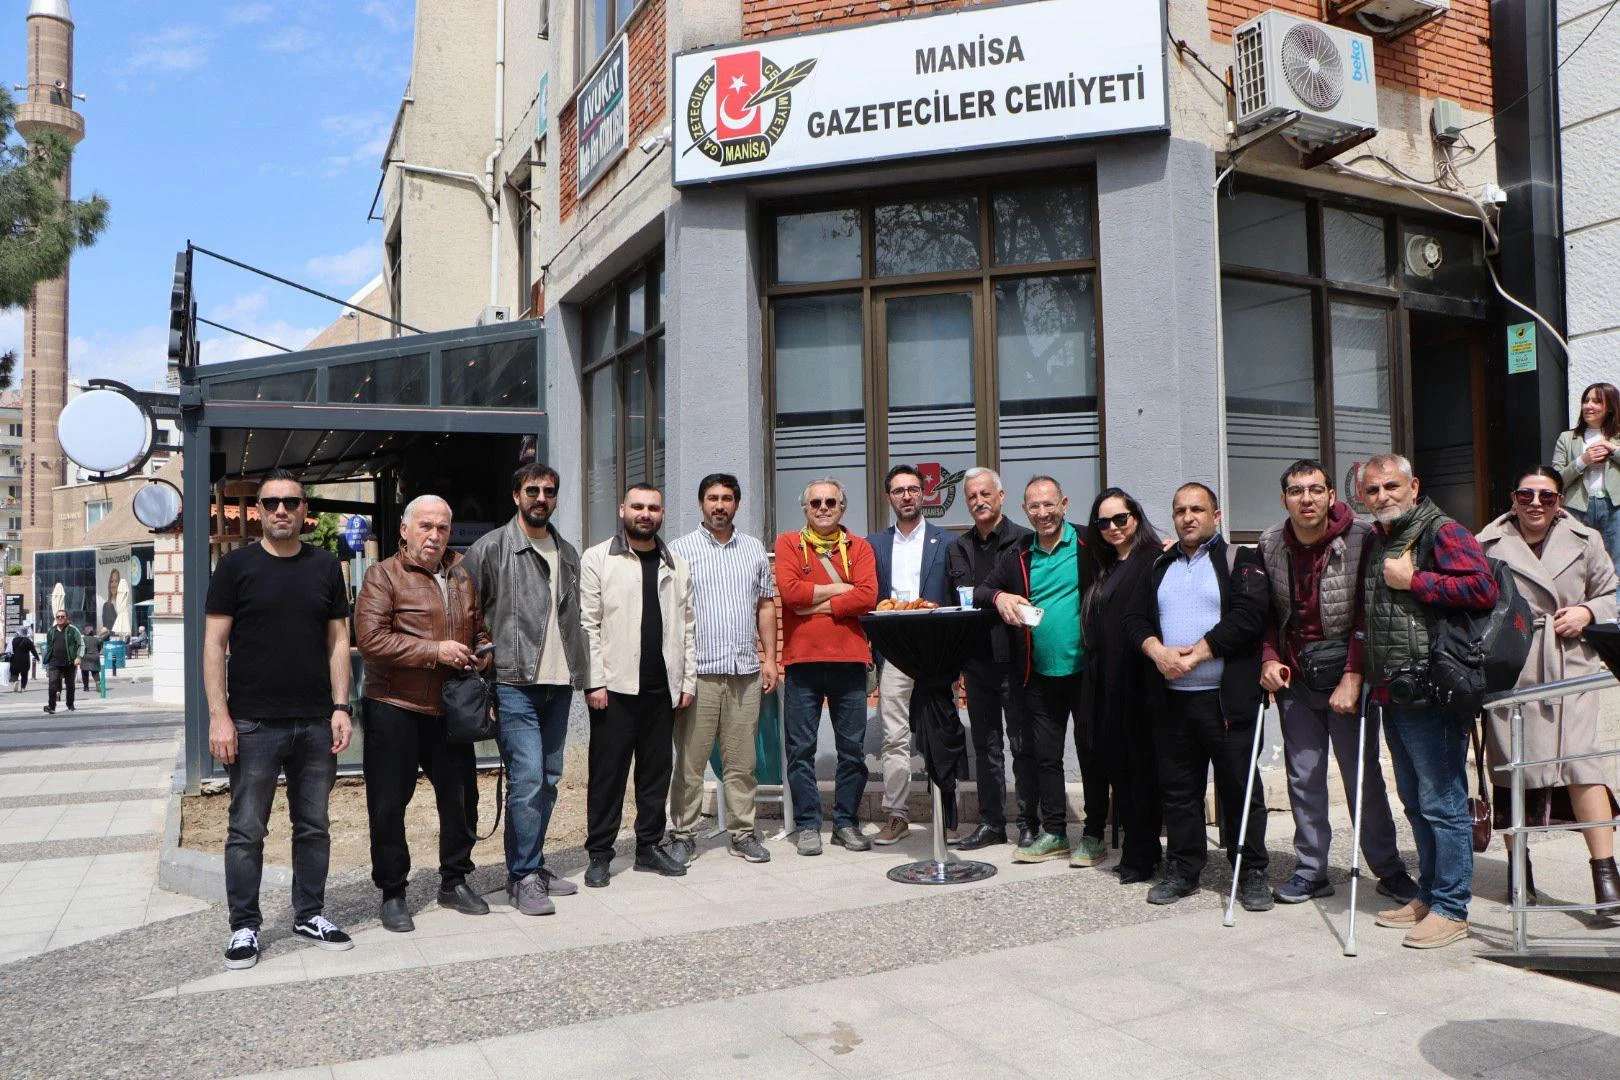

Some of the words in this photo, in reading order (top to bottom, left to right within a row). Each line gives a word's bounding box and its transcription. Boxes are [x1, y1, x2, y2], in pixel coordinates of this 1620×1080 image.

[915, 33, 1026, 75] MANİSA
[1352, 40, 1363, 81] beko
[583, 56, 621, 130] AVUKAT
[807, 89, 997, 139] GAZETECİLER
[1005, 64, 1145, 115] CEMİYETİ
[725, 139, 768, 162] MANİSA
